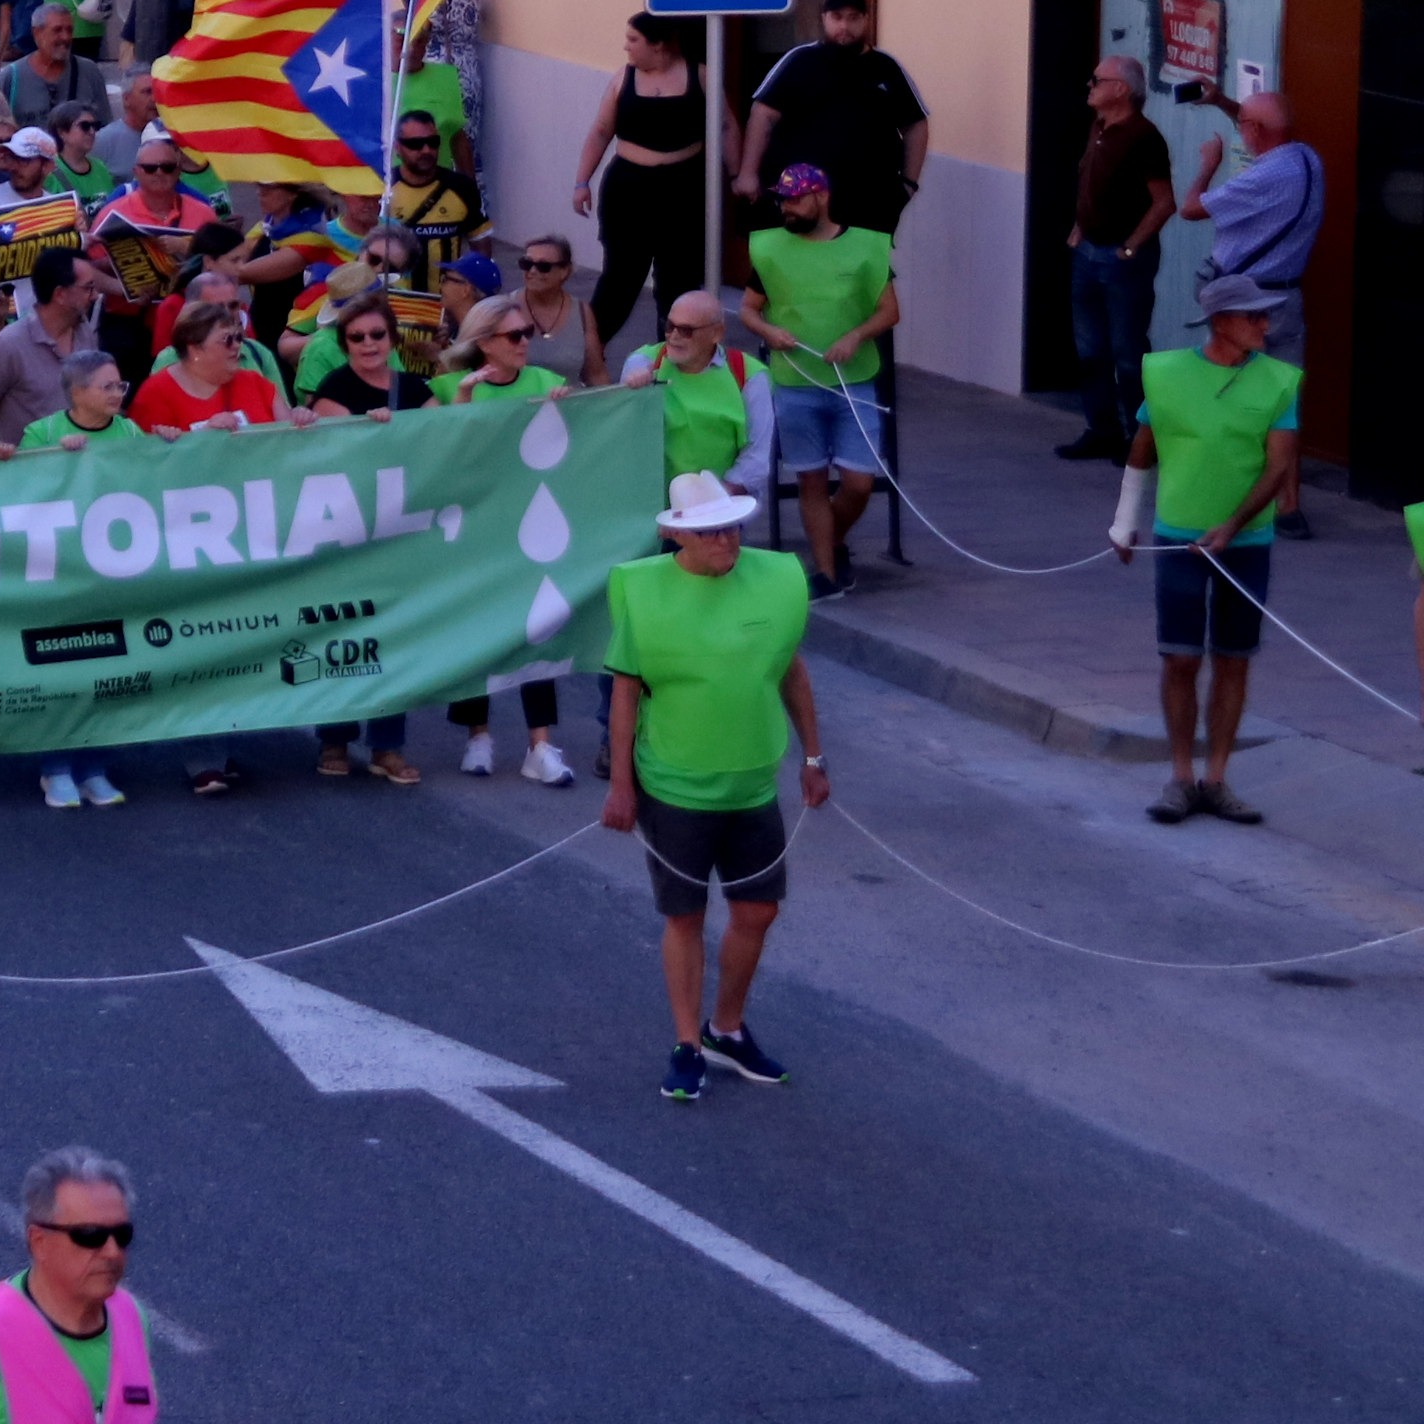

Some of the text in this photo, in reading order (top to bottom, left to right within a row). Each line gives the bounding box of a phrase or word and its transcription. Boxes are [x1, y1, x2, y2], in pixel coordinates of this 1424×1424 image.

[179, 611, 280, 638] ÒMNIUM
[35, 630, 116, 654] assemblea
[325, 637, 380, 667] CDR
[325, 664, 383, 679] CATALUNYA
[5, 683, 42, 697] Consell
[93, 682, 154, 702] SINDICAL
[94, 677, 133, 691] INTER
